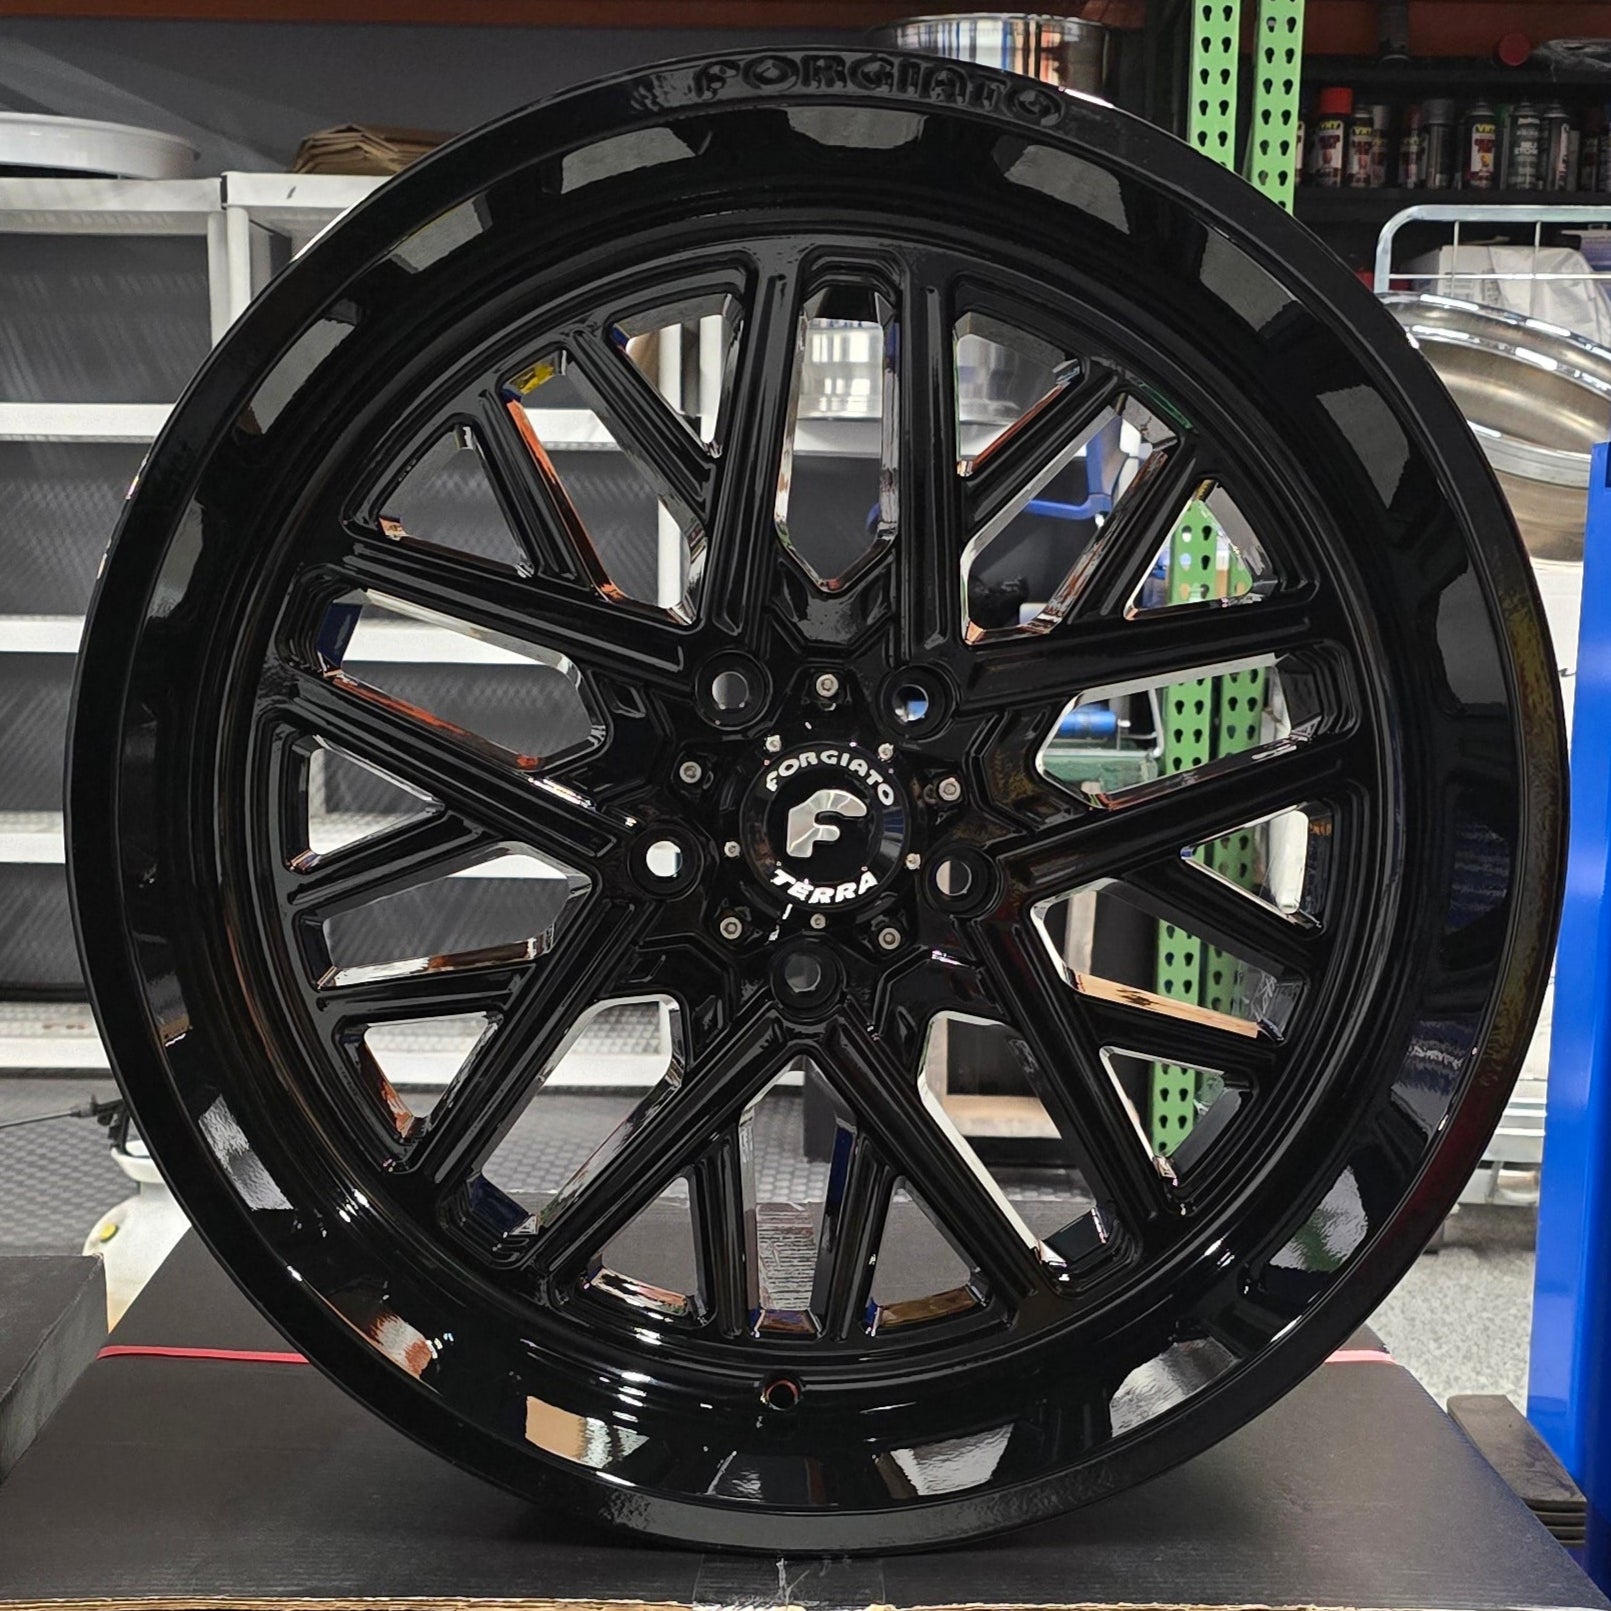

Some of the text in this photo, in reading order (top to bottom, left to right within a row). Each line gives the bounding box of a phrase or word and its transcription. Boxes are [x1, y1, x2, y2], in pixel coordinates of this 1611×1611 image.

[692, 52, 1065, 127] FORGIATO
[765, 750, 895, 806] FORGIATO
[770, 870, 878, 904] TERRA
